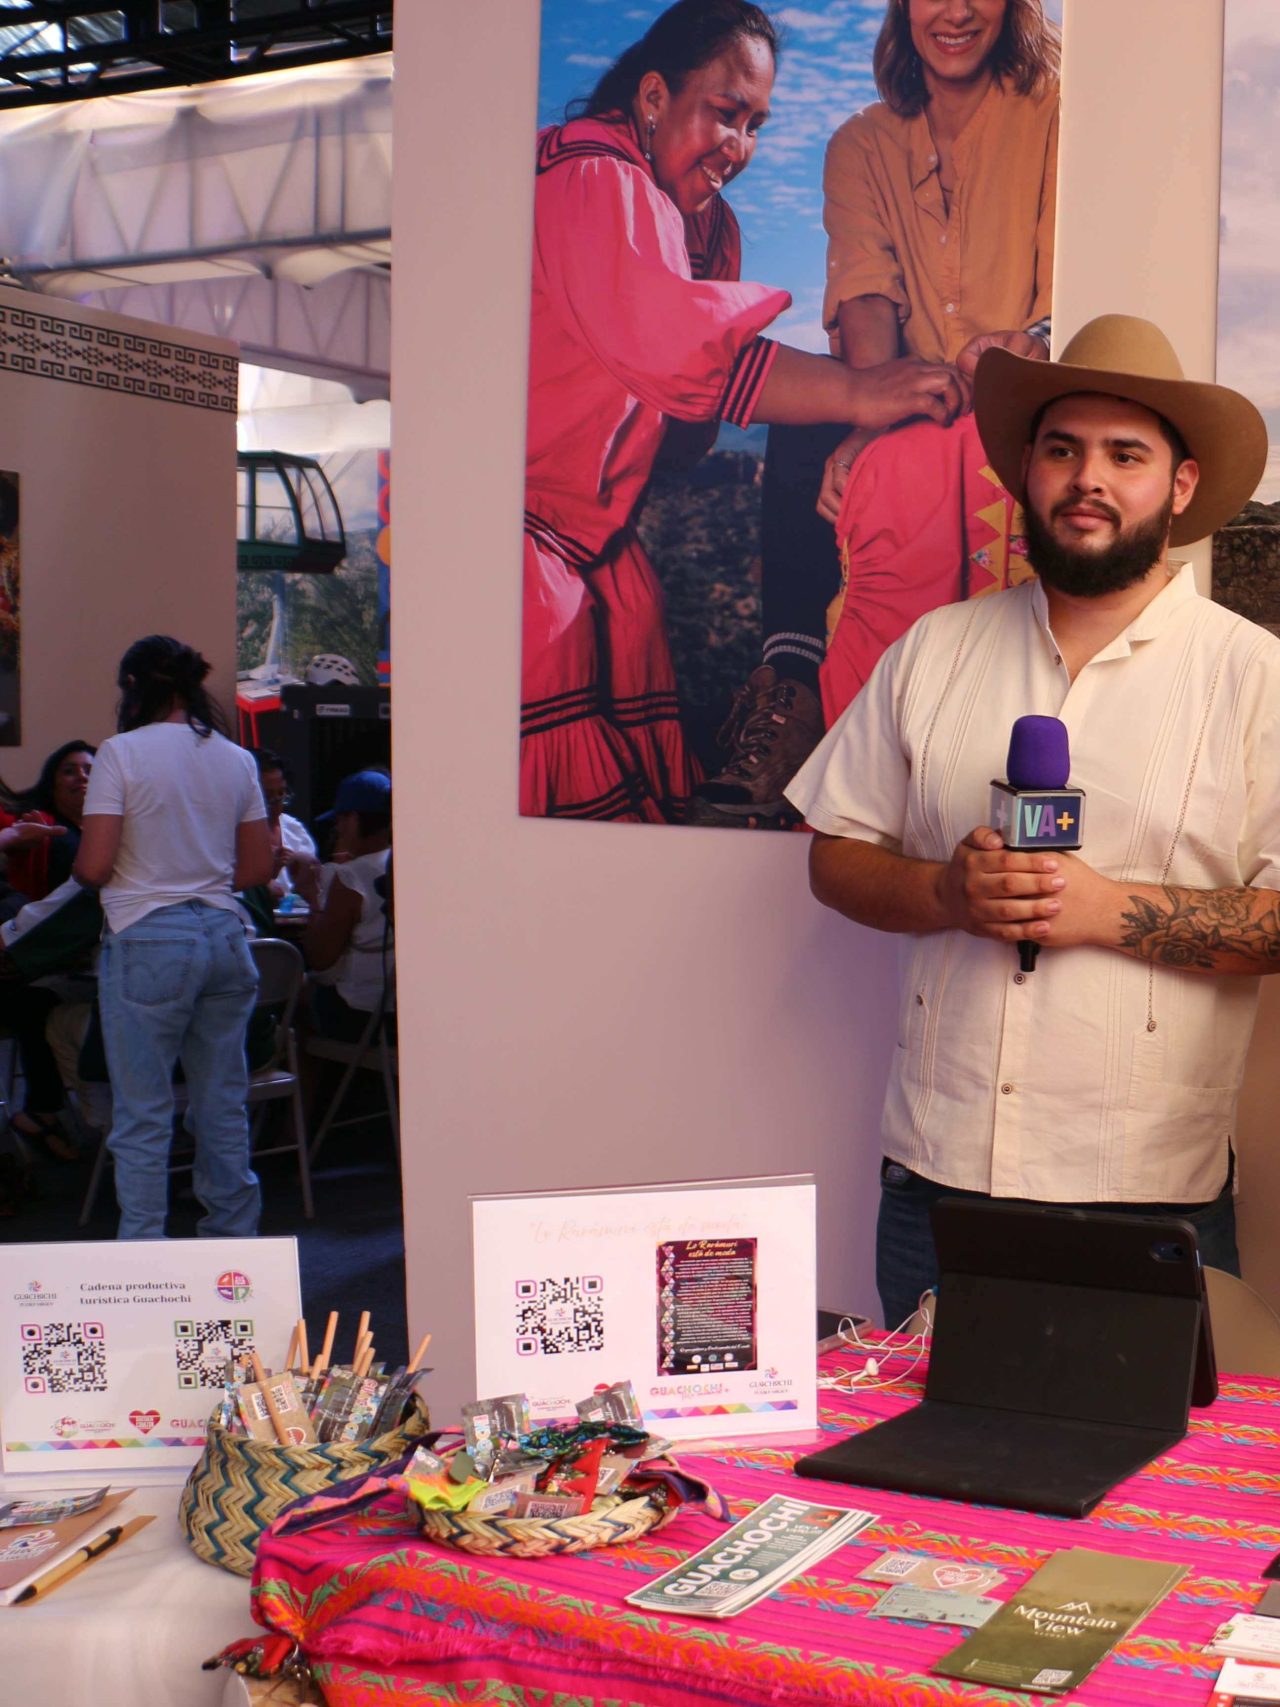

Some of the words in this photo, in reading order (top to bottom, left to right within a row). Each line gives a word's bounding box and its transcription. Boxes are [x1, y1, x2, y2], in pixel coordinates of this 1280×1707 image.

[80, 1283, 122, 1291] Cadena
[126, 1281, 186, 1292] productiva
[132, 1294, 192, 1304] Guachochi
[663, 1501, 811, 1596] GUACHOCHI
[1013, 1604, 1117, 1628] Mountain
[1034, 1619, 1086, 1635] View
